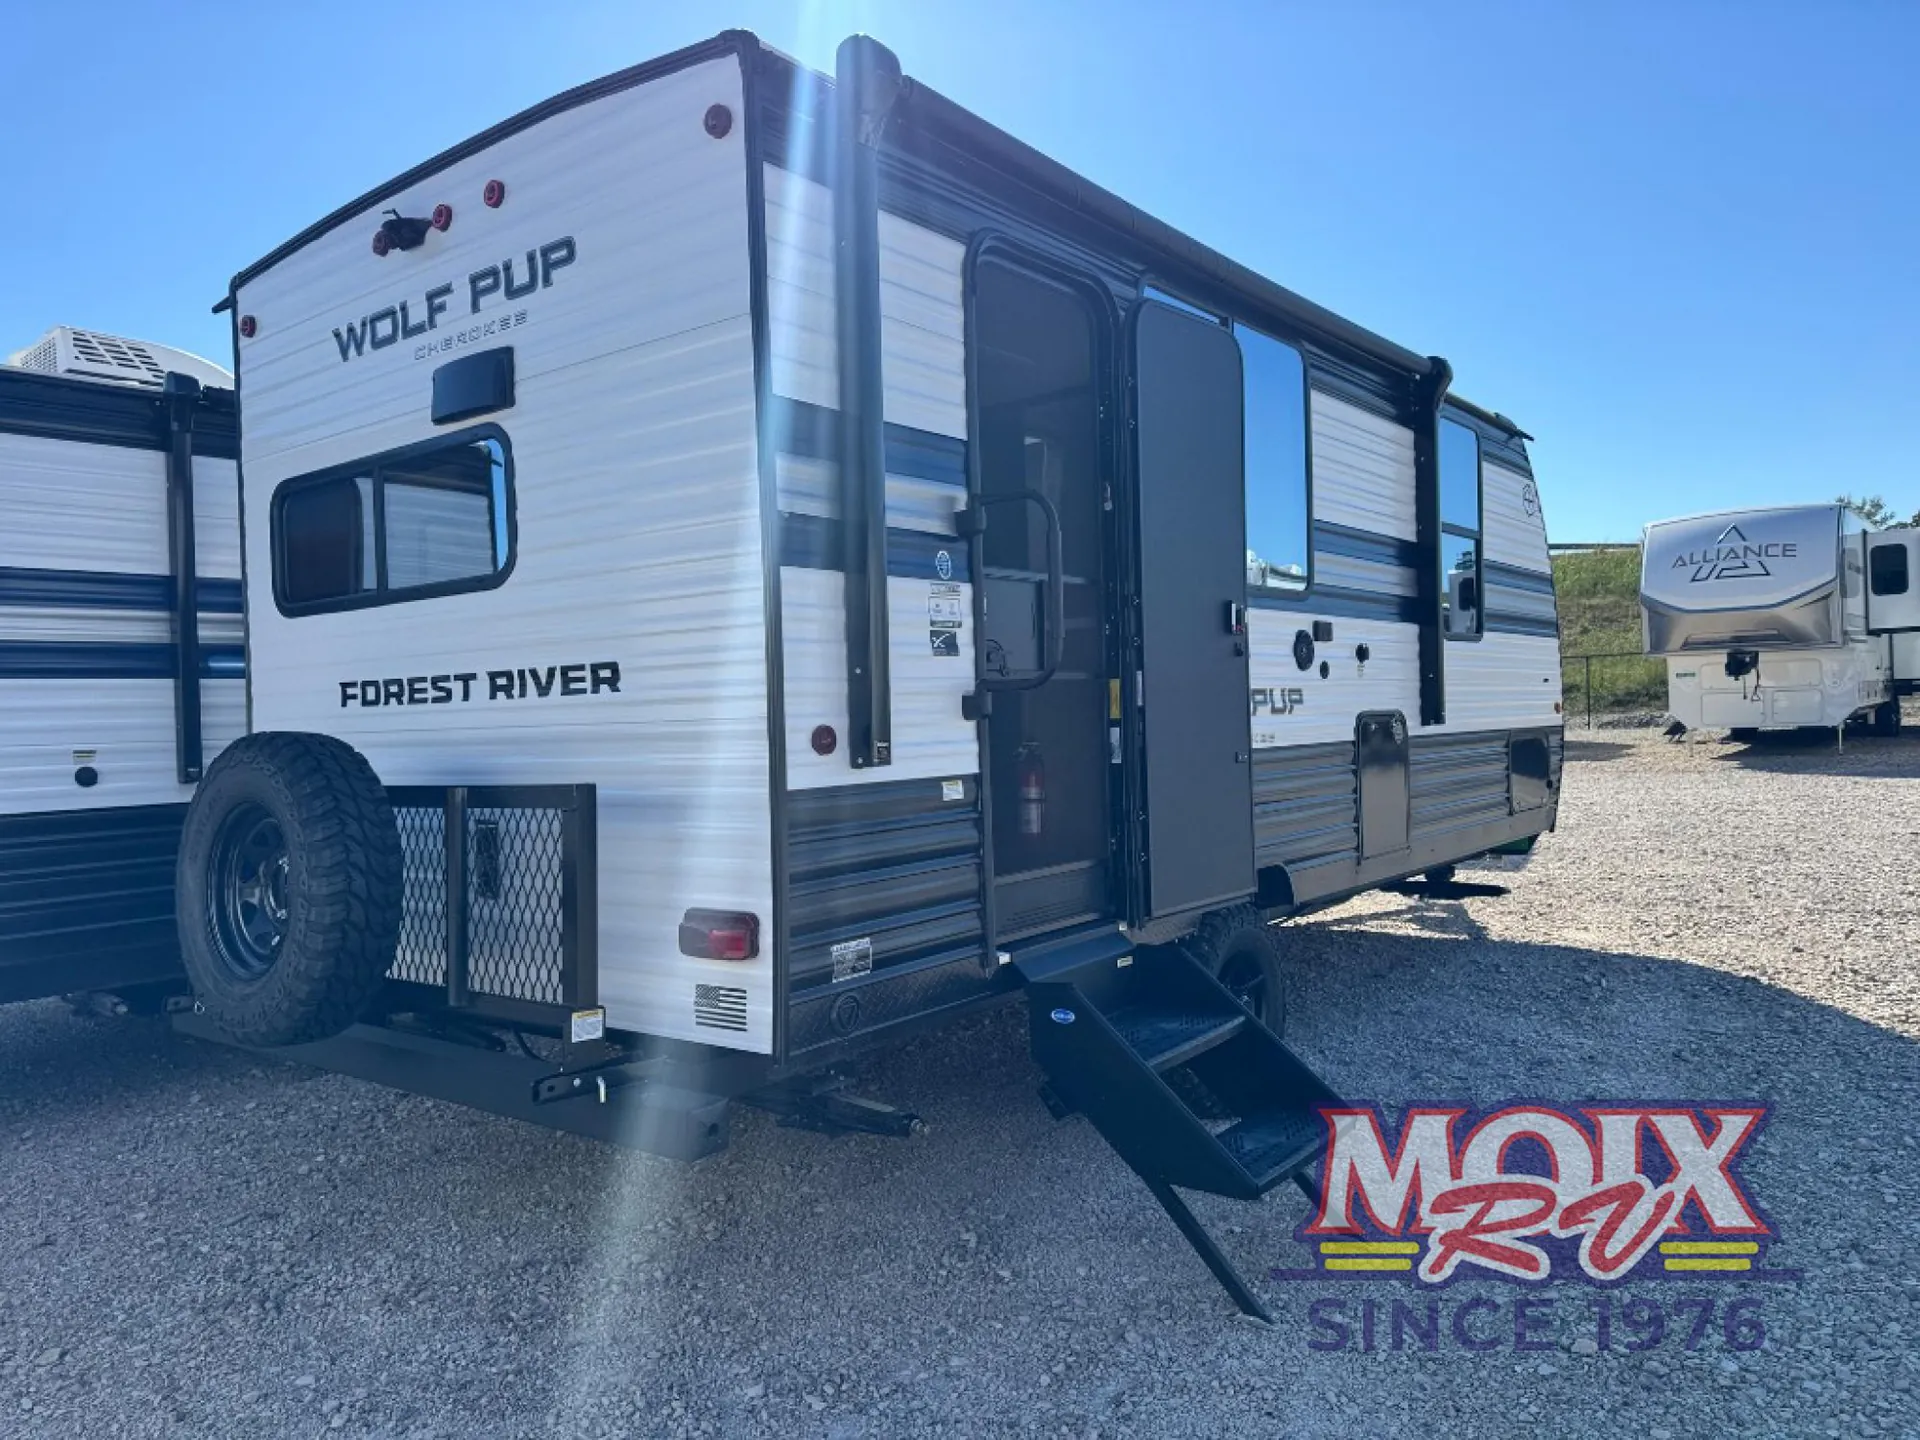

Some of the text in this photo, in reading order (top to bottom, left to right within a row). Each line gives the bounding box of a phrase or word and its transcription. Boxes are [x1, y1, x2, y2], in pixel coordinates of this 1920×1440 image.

[332, 235, 576, 363] WOLF PUP
[414, 309, 529, 361] CHEROKEE
[1672, 543, 1797, 569] ALLIANCE
[339, 661, 622, 708] FOREST RIVER
[1251, 687, 1304, 717] PUP
